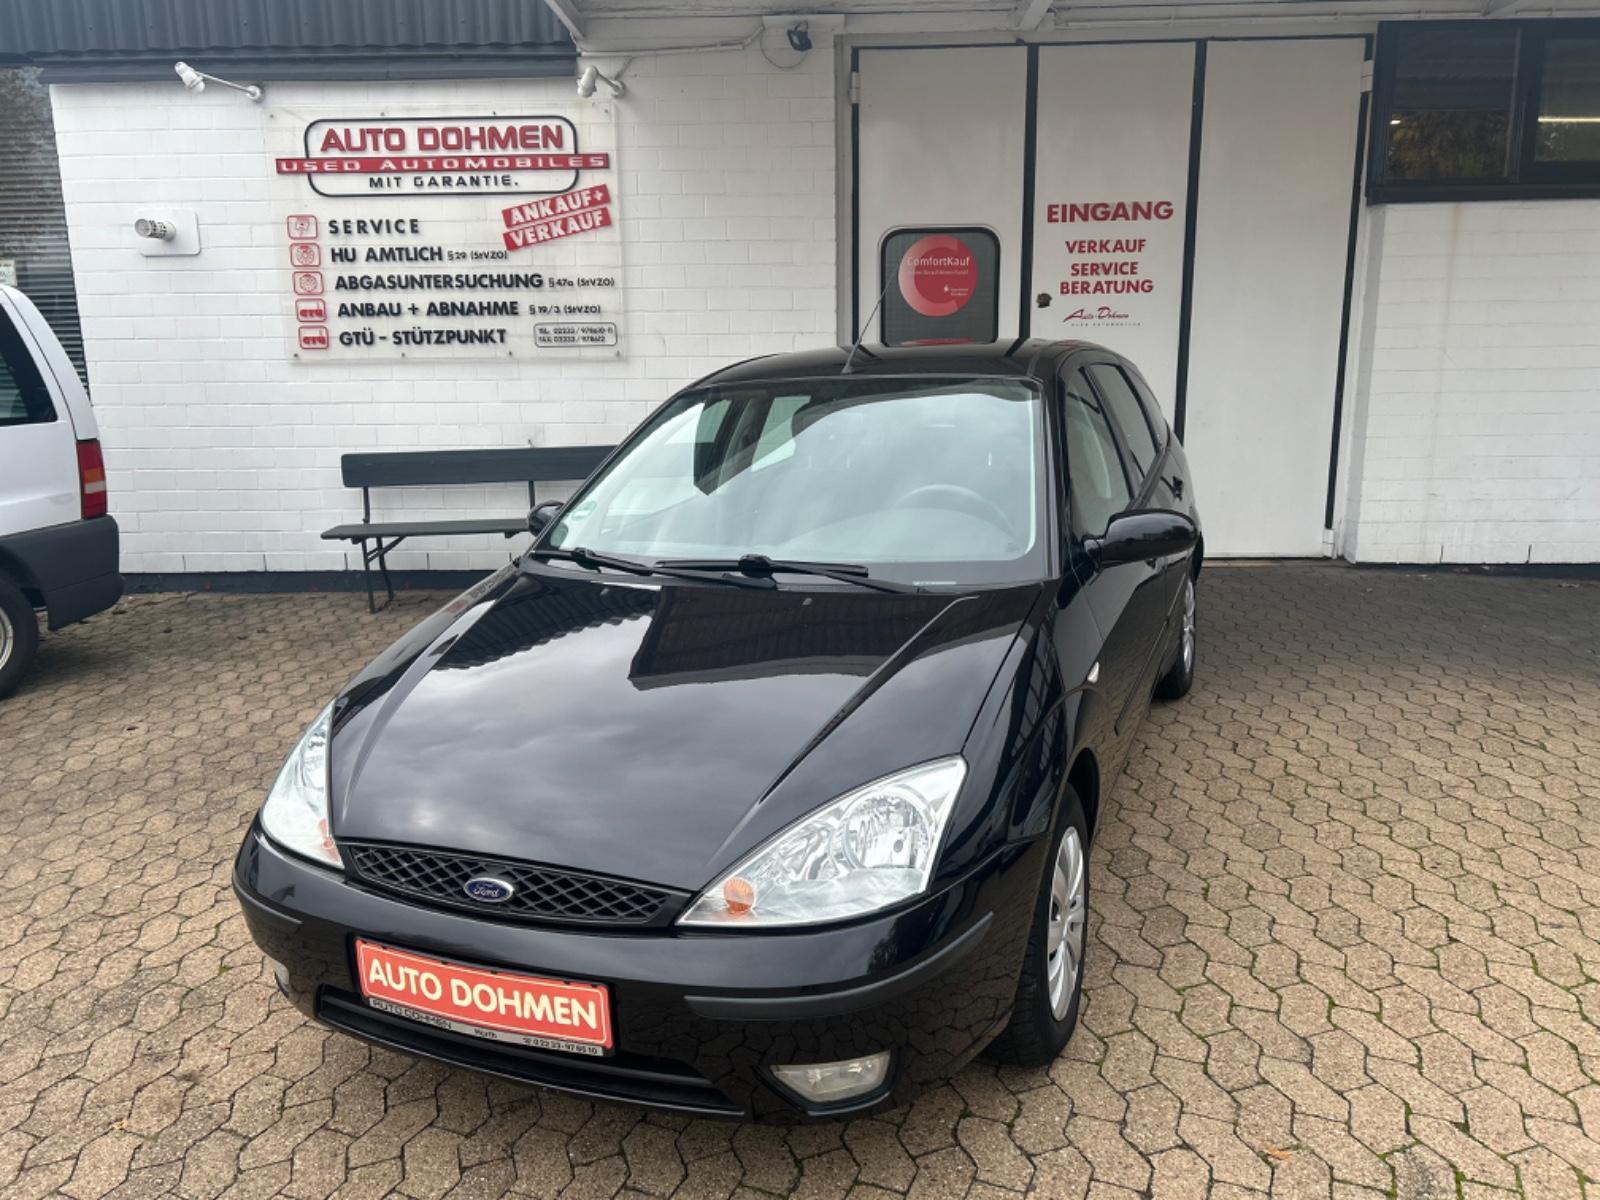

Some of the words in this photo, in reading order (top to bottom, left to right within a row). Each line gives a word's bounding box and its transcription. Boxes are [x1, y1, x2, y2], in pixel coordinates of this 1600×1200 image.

[320, 127, 406, 153] AUTO
[417, 124, 563, 151] DOHMEN
[281, 160, 361, 172] USED
[379, 155, 605, 171] AUTOMOBILES
[369, 177, 402, 188] MIT
[413, 174, 518, 187] GARANTIE.
[1047, 201, 1174, 222] EINGANG
[328, 218, 419, 234] SERVICE
[510, 211, 603, 247] VERKAUF
[331, 247, 356, 263] HU
[365, 246, 443, 262] AMTLICH
[1065, 239, 1147, 254] VERKAUF
[1071, 262, 1138, 276] SERVICE
[335, 273, 543, 290] ABGASUNTERSUCHUNG
[1060, 279, 1154, 295] BERATUNG
[338, 302, 401, 317] ANBAU
[408, 303, 419, 316] +
[426, 301, 519, 317] ABNAHME
[340, 327, 374, 346] GTÜ
[393, 326, 507, 345] STÜTZPUNKT
[474, 887, 499, 898] Ford
[369, 958, 442, 1000] AUTO
[451, 978, 597, 1029] DOHMEN
